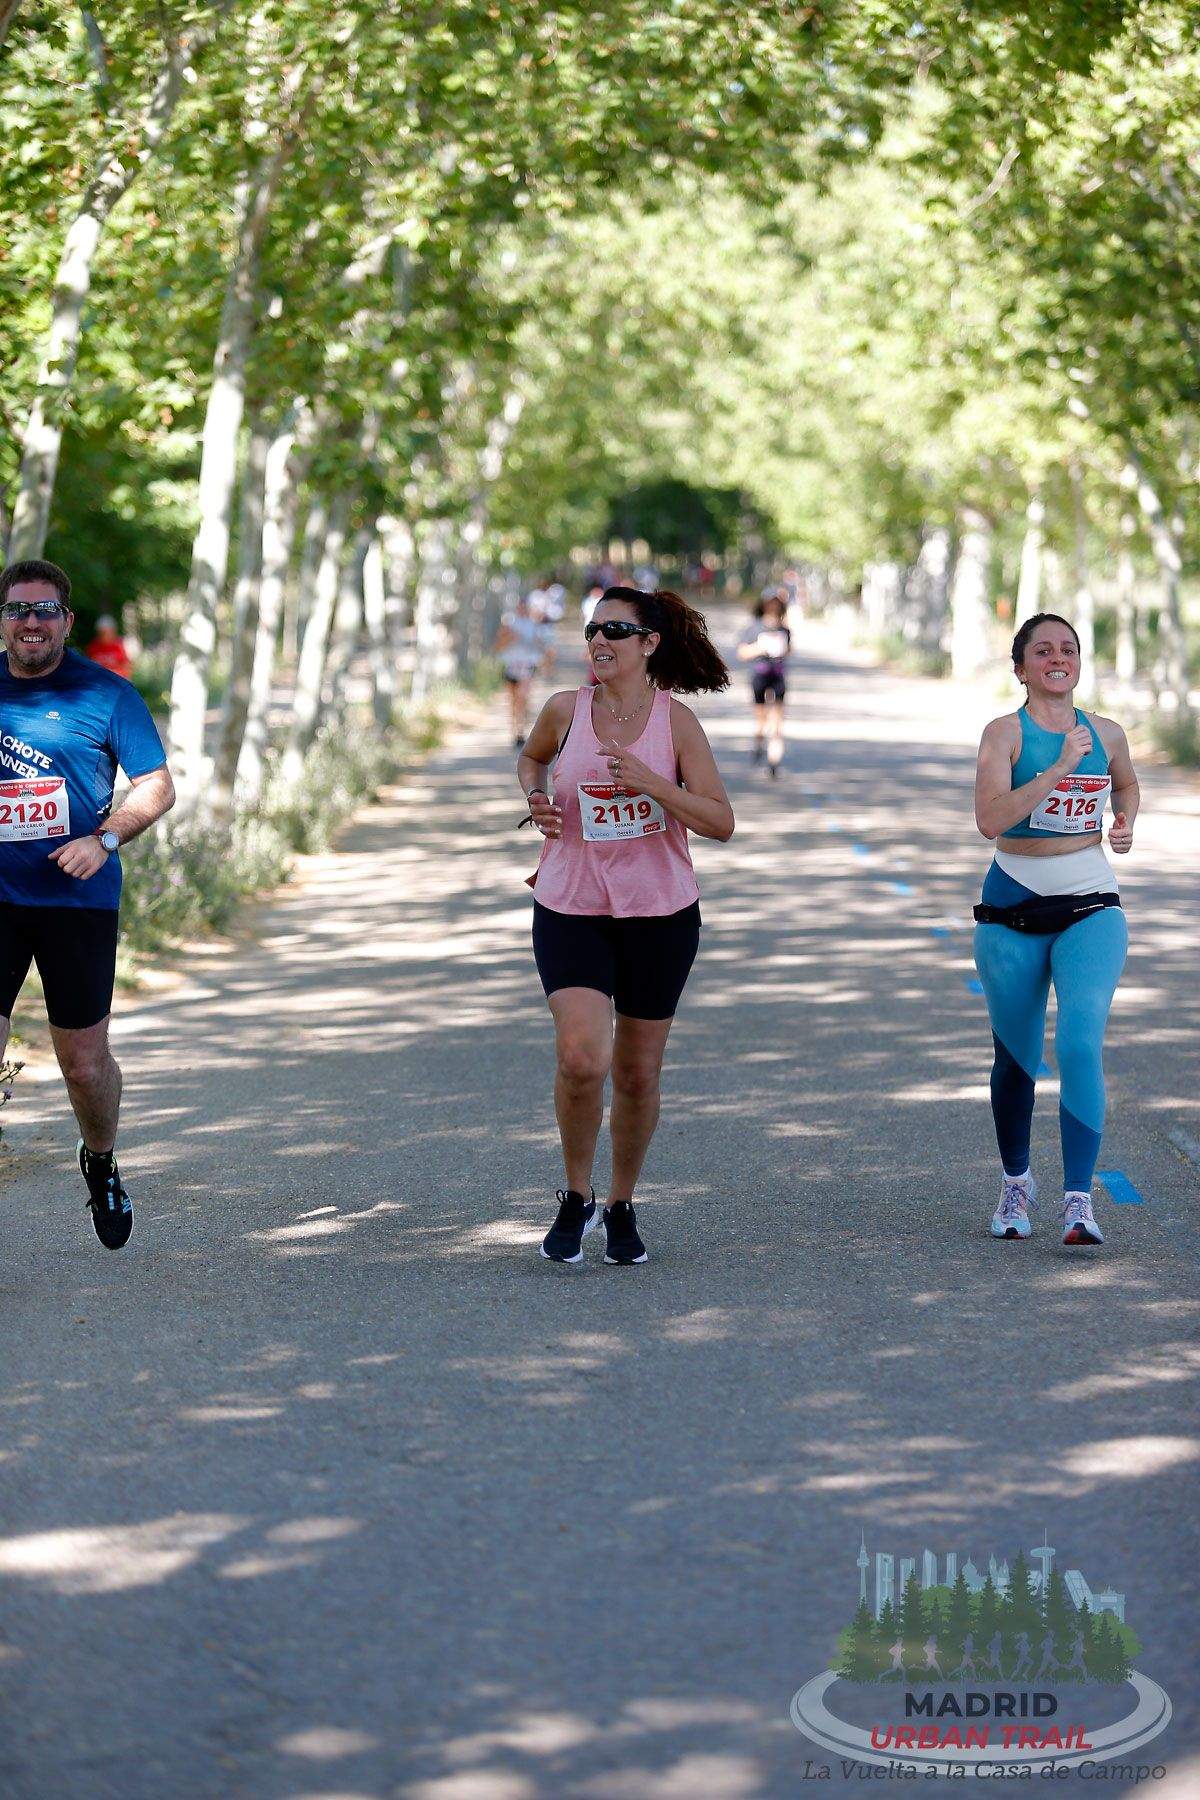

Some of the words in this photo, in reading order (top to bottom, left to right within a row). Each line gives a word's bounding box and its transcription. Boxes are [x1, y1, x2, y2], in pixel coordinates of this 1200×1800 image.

[0, 730, 53, 769] CHOTE
[0, 801, 57, 824] 2120
[592, 800, 652, 824] 2119
[1044, 797, 1099, 817] 2126
